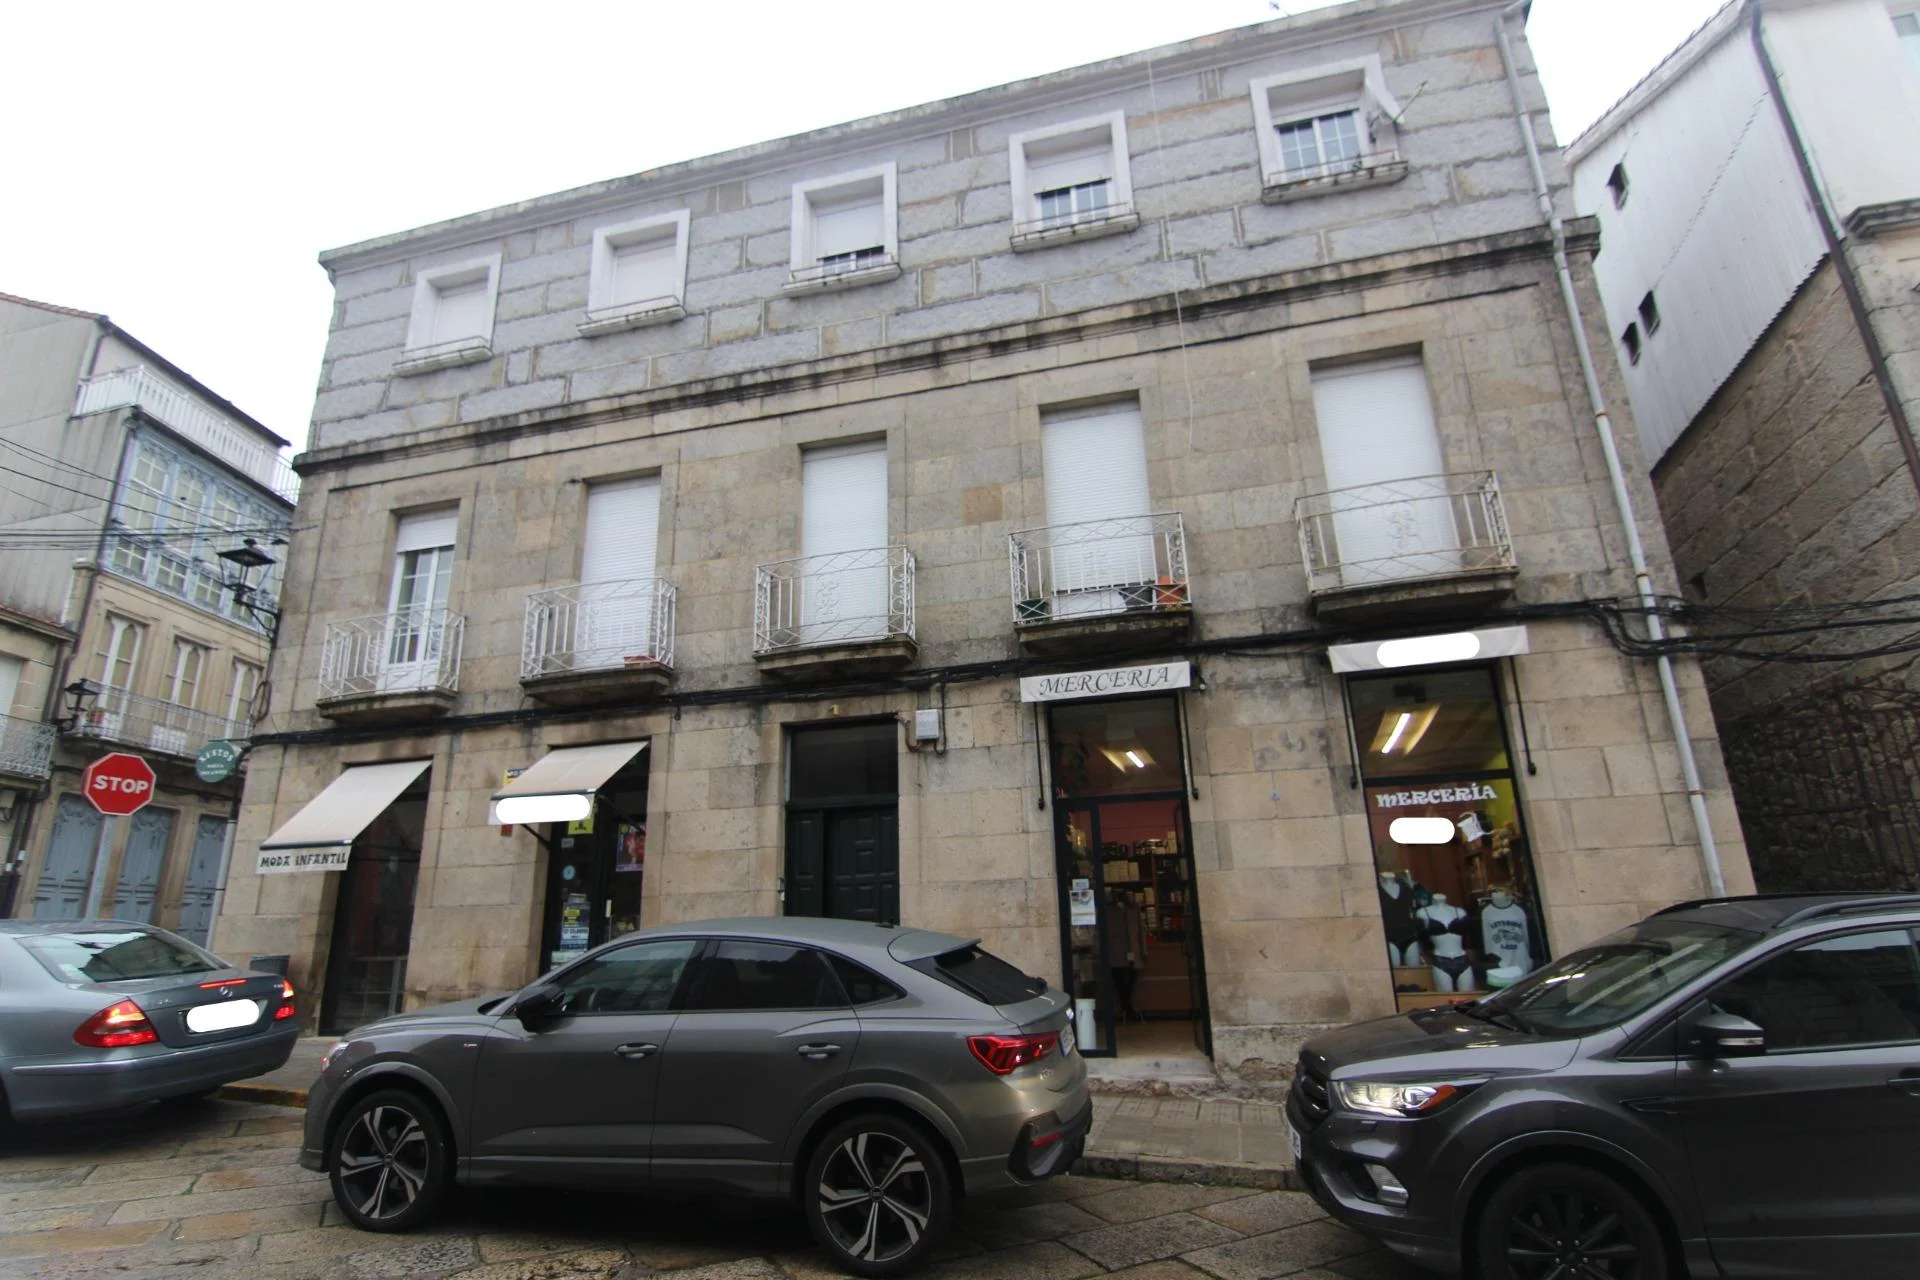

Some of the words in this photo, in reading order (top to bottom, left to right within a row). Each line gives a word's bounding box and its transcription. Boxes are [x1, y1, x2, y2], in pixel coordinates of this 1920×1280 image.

[1039, 666, 1169, 696] MERCERIA
[93, 774, 149, 794] STOP
[260, 855, 291, 867] MODA
[295, 852, 347, 866] INFANTIL
